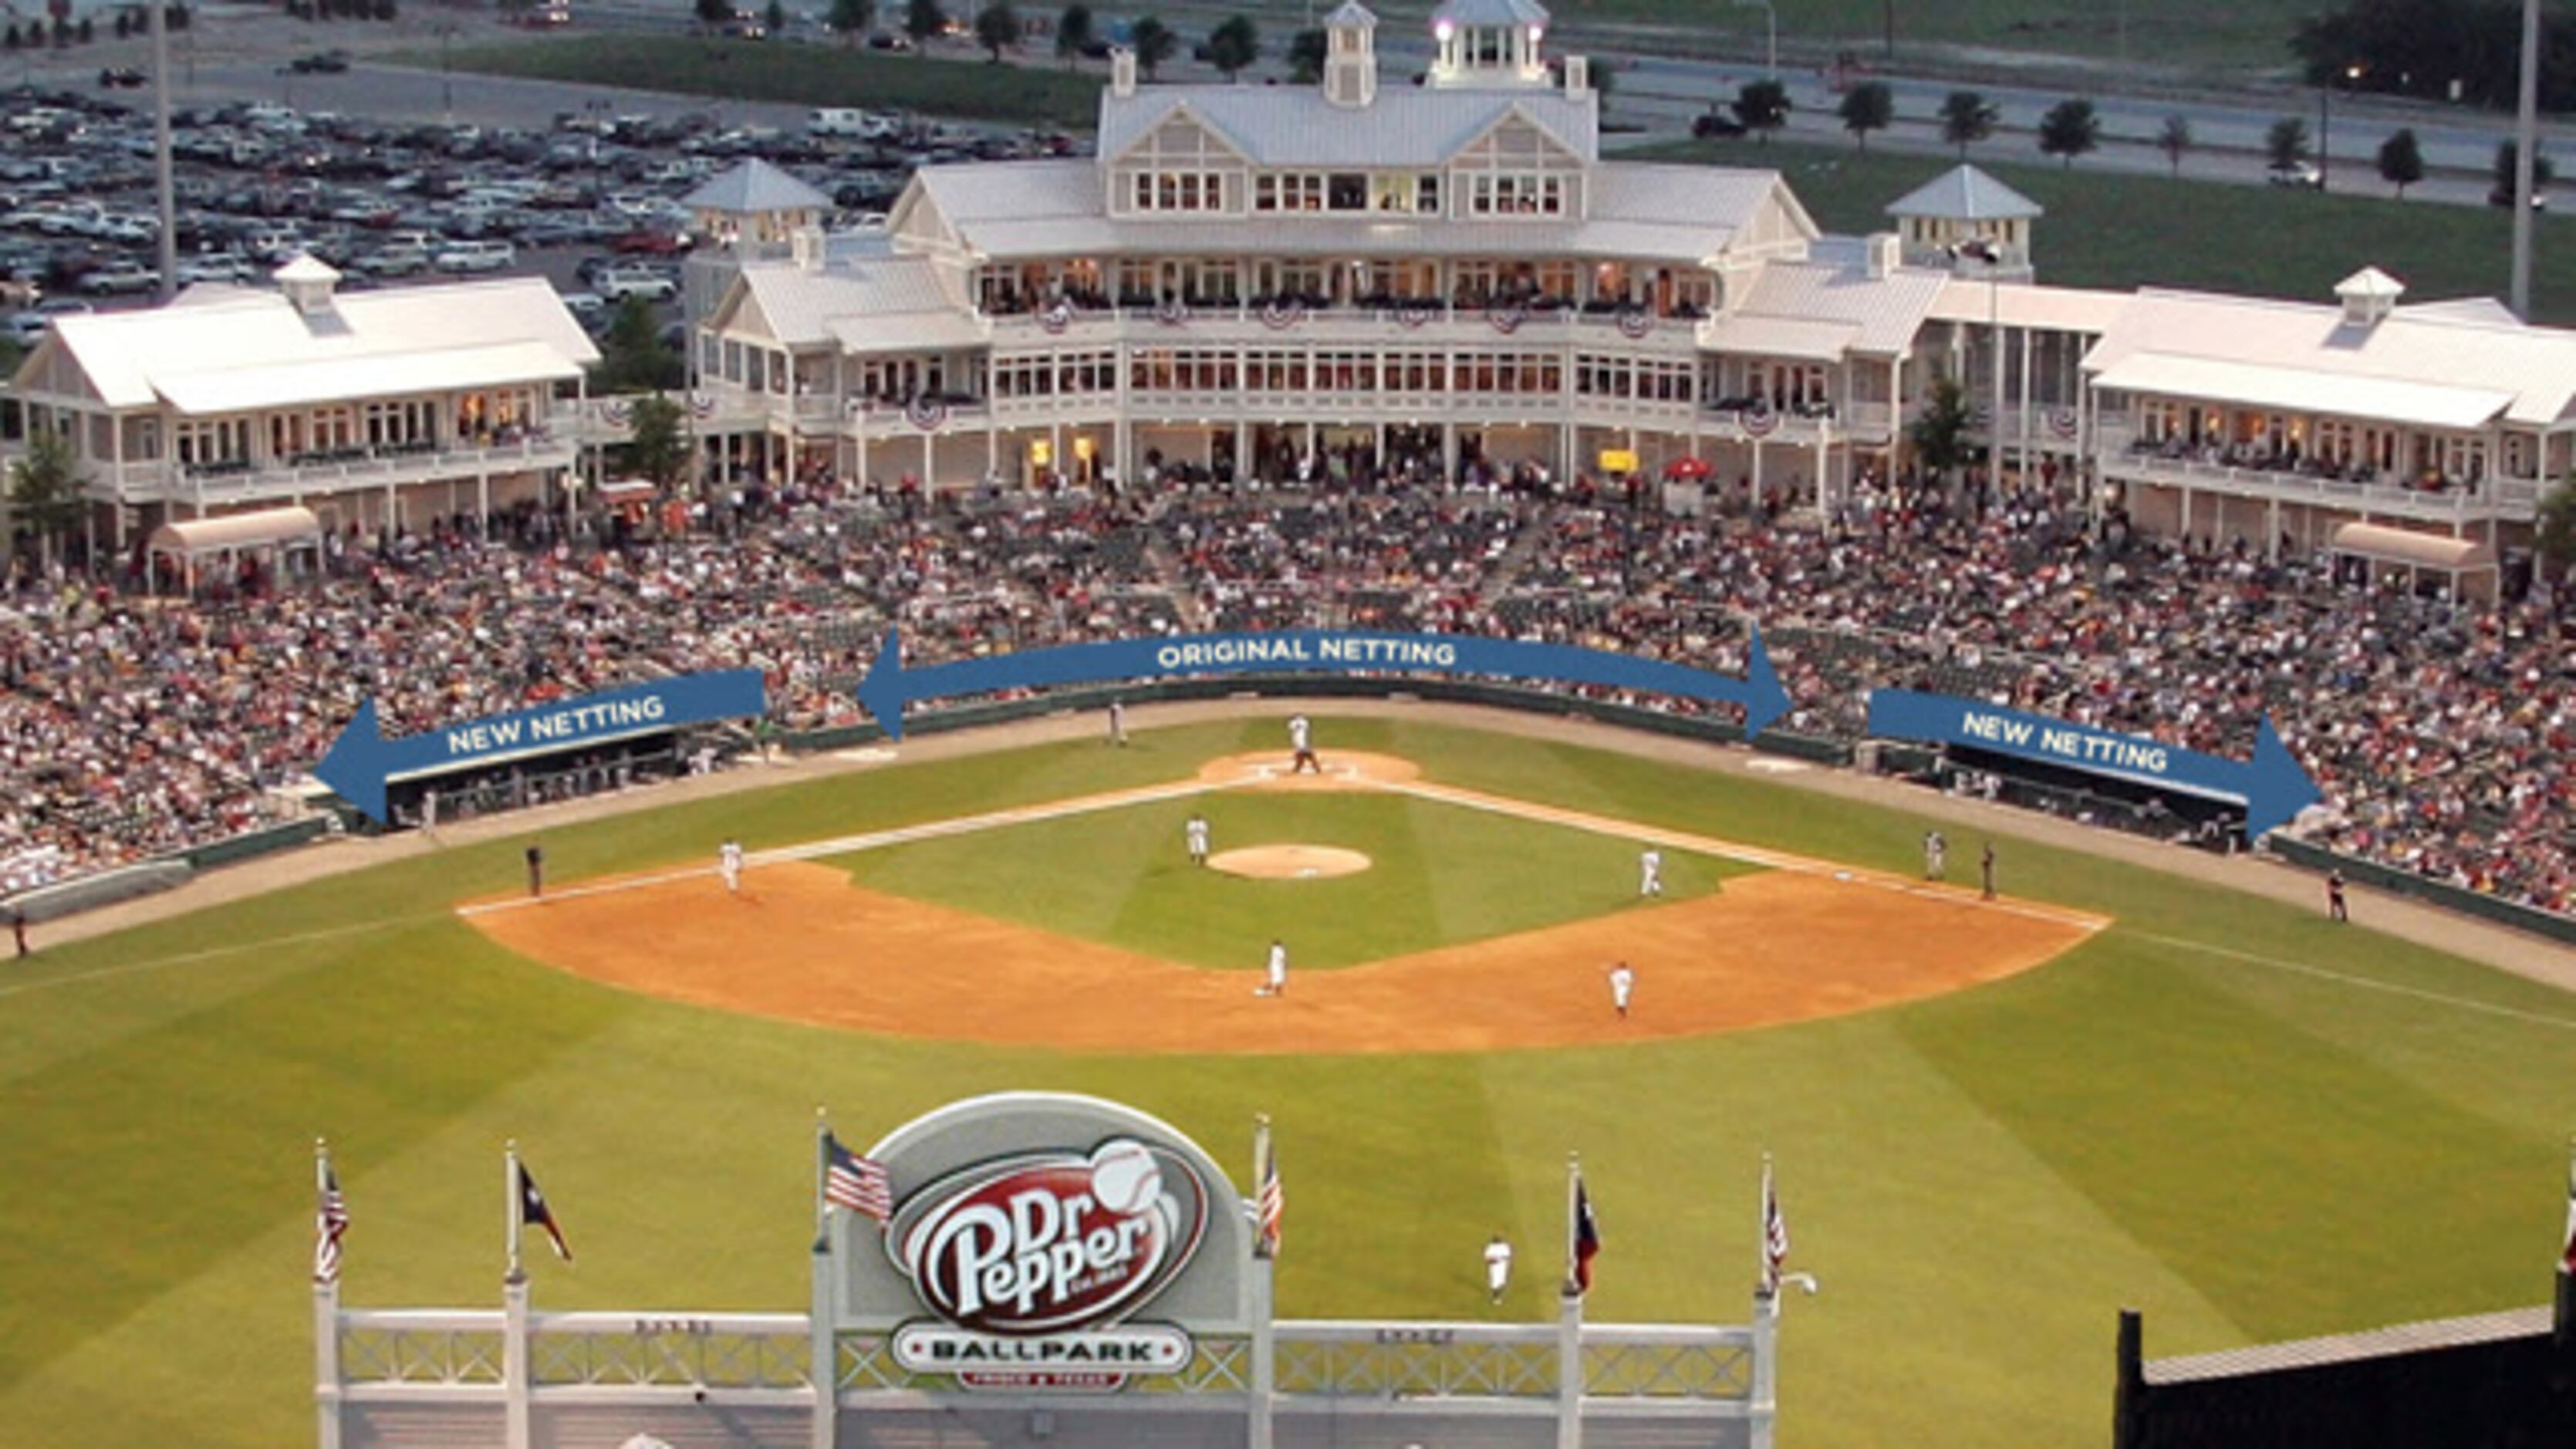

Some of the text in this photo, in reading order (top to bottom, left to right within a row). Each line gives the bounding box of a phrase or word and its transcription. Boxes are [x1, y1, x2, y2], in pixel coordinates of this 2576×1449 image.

[1011, 1189, 1092, 1253] Dr
[927, 1204, 1146, 1315] Pepper
[932, 1341, 1153, 1360] BALLPARK
